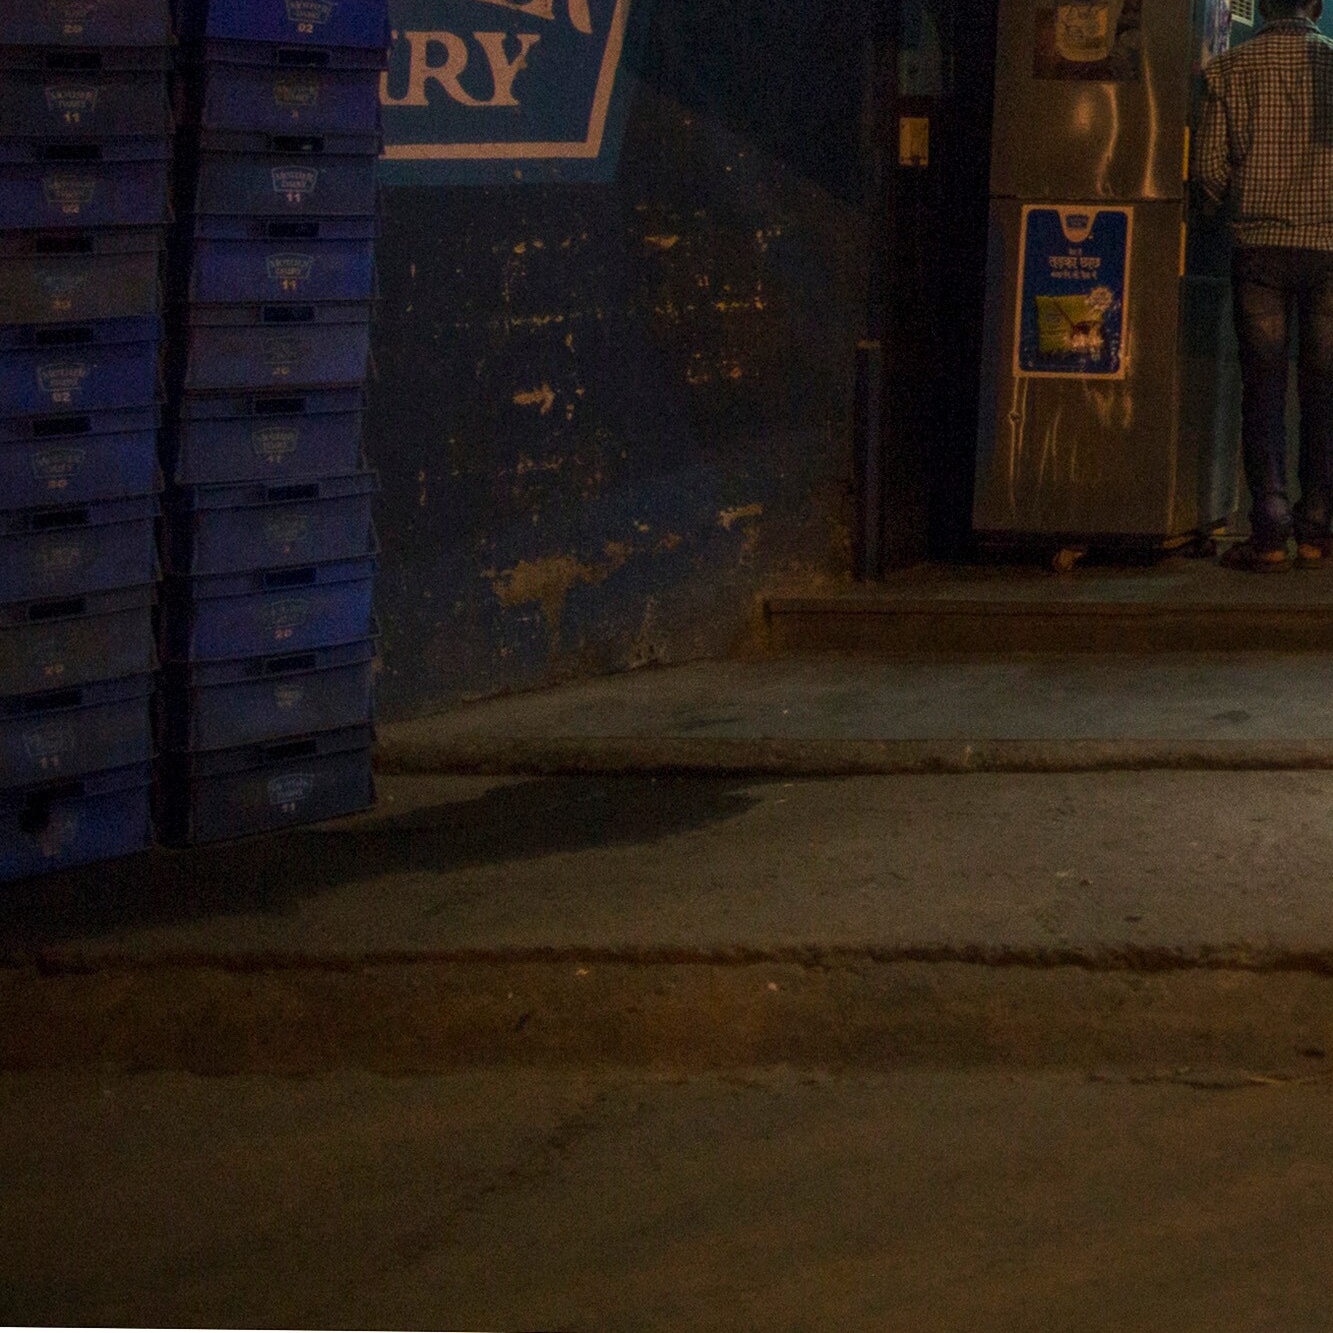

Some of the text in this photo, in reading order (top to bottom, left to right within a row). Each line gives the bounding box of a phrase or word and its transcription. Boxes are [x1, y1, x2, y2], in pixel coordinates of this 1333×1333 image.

[297, 23, 314, 34] 02
[63, 111, 81, 124] 11
[286, 192, 301, 203] 11
[281, 280, 297, 291] 11
[52, 391, 71, 403] 02
